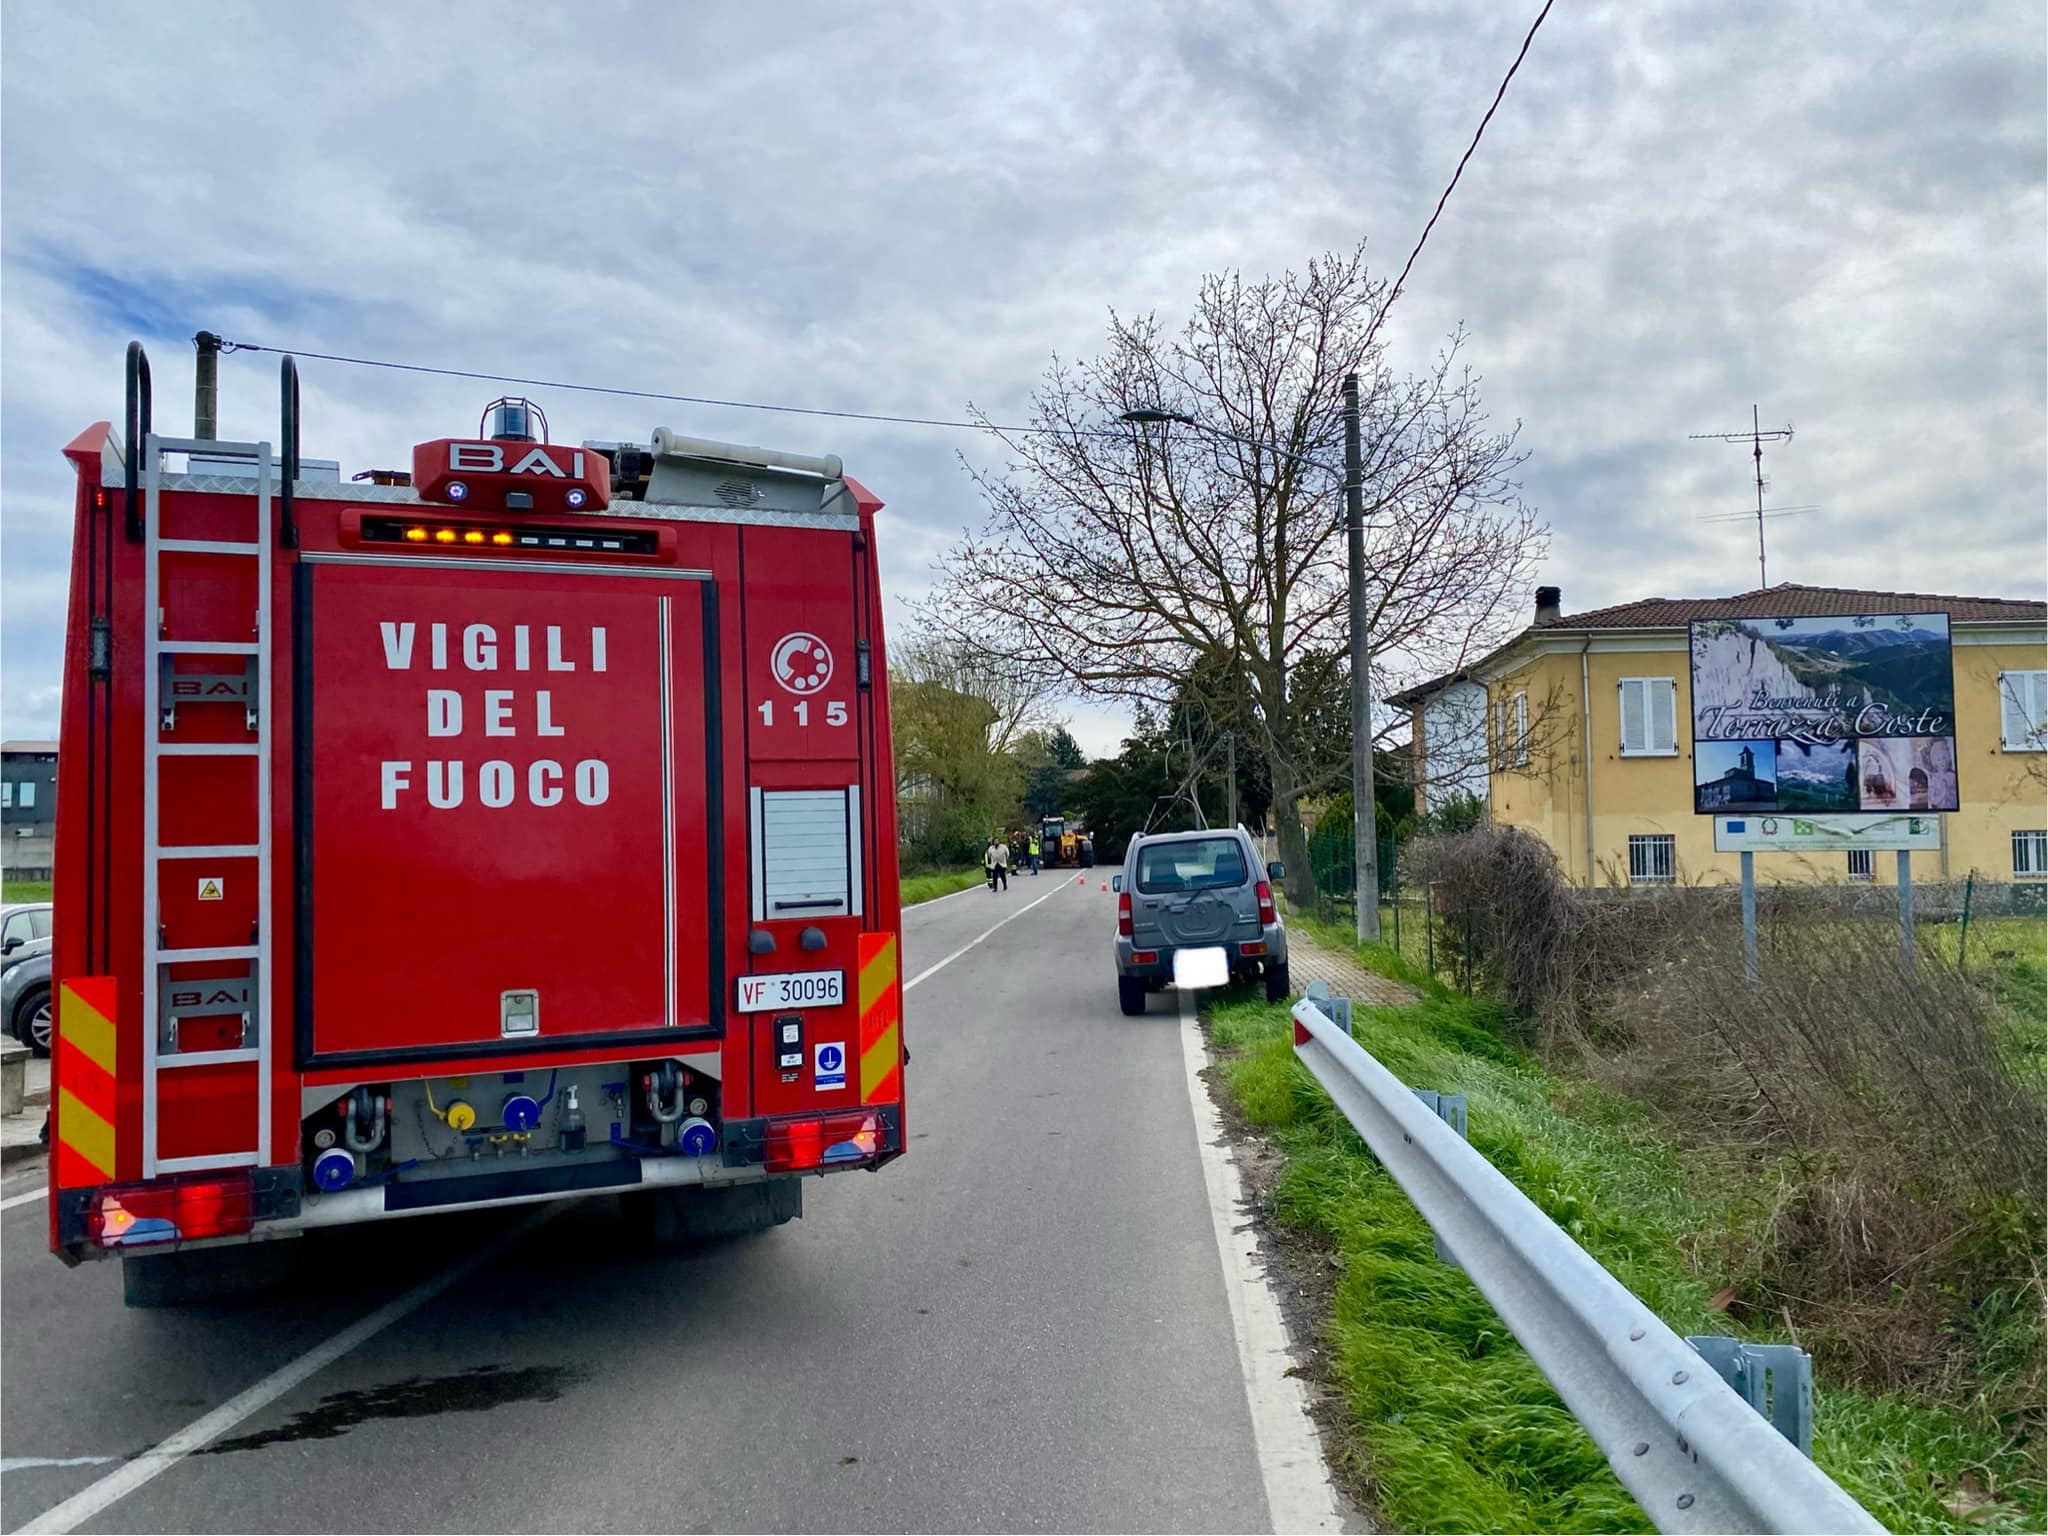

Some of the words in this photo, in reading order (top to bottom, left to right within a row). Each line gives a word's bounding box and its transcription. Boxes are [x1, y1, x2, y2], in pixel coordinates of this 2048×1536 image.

[449, 443, 585, 480] BAI
[379, 622, 607, 672] VIGILI
[172, 681, 248, 695] BAI
[1749, 689, 1838, 710] Benvenuti
[1846, 694, 1858, 708] a
[427, 689, 565, 737] DEL
[757, 700, 848, 727] 115
[1698, 700, 1842, 745] Torrazza
[1855, 702, 1949, 735] Coste
[381, 759, 609, 809] FUOCO
[172, 988, 248, 1007] BAI
[743, 982, 766, 1005] VF
[780, 977, 838, 1002] 30096
